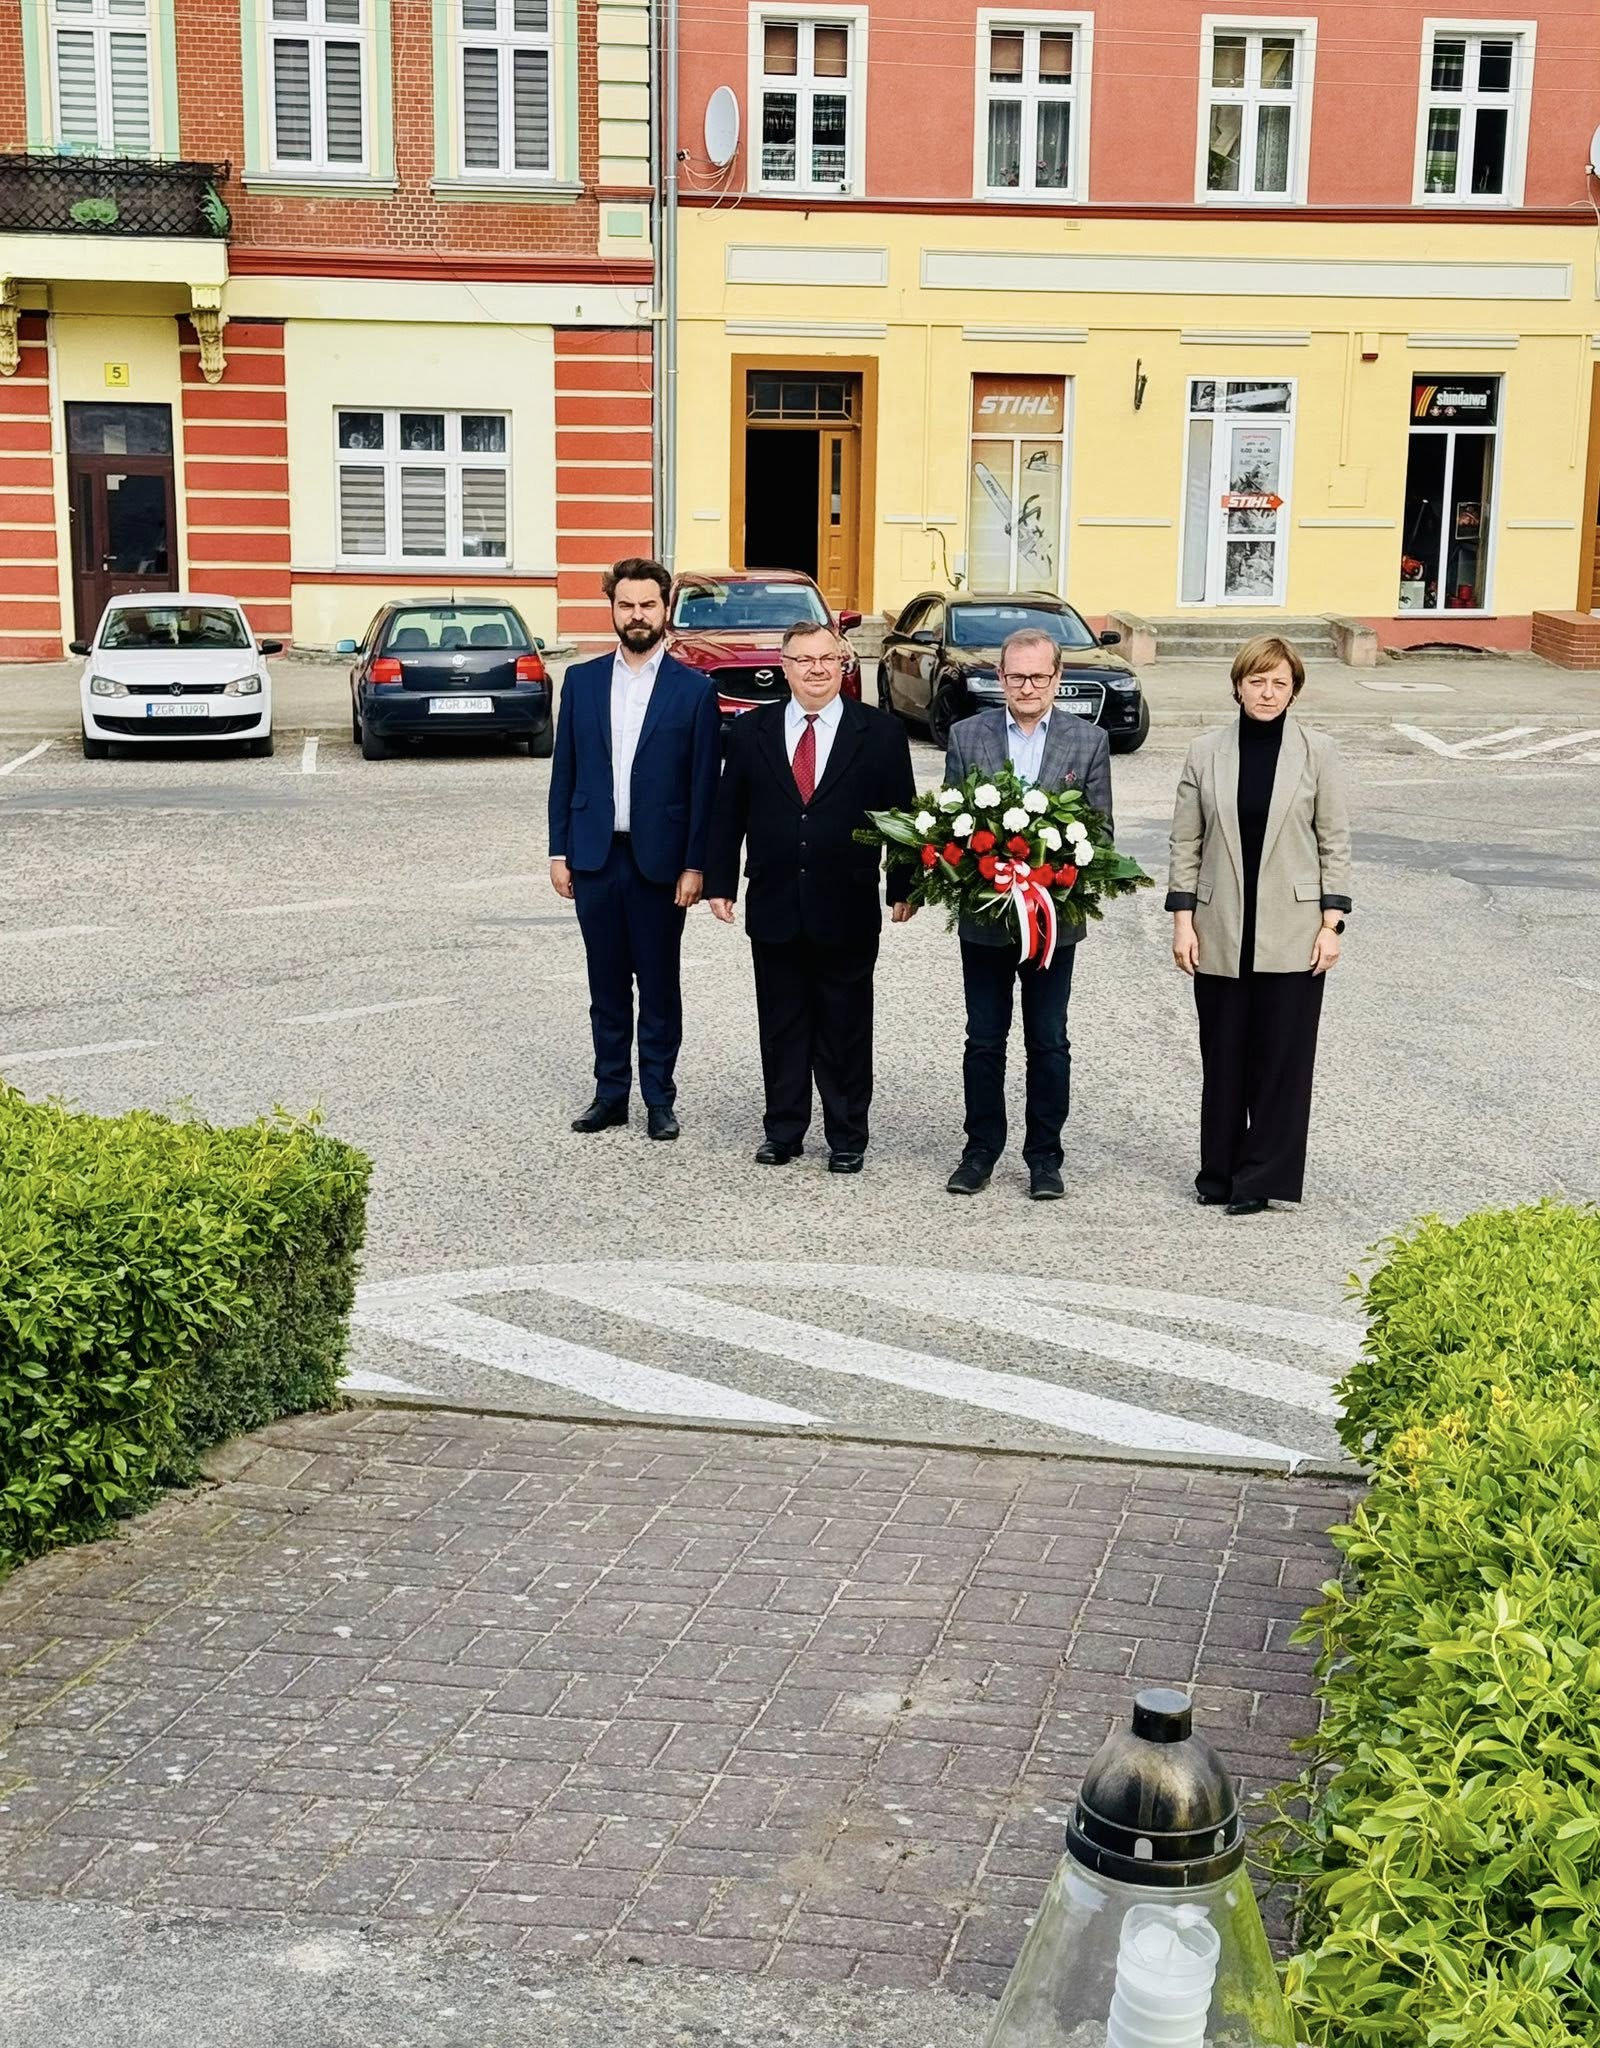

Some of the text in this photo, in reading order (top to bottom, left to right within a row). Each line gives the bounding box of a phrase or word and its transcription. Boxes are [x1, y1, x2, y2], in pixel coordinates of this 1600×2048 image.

[112, 366, 122, 380] 5
[977, 395, 1056, 415] STIHL
[1227, 496, 1272, 508] STIHL
[155, 704, 206, 715] ZGR 1U99
